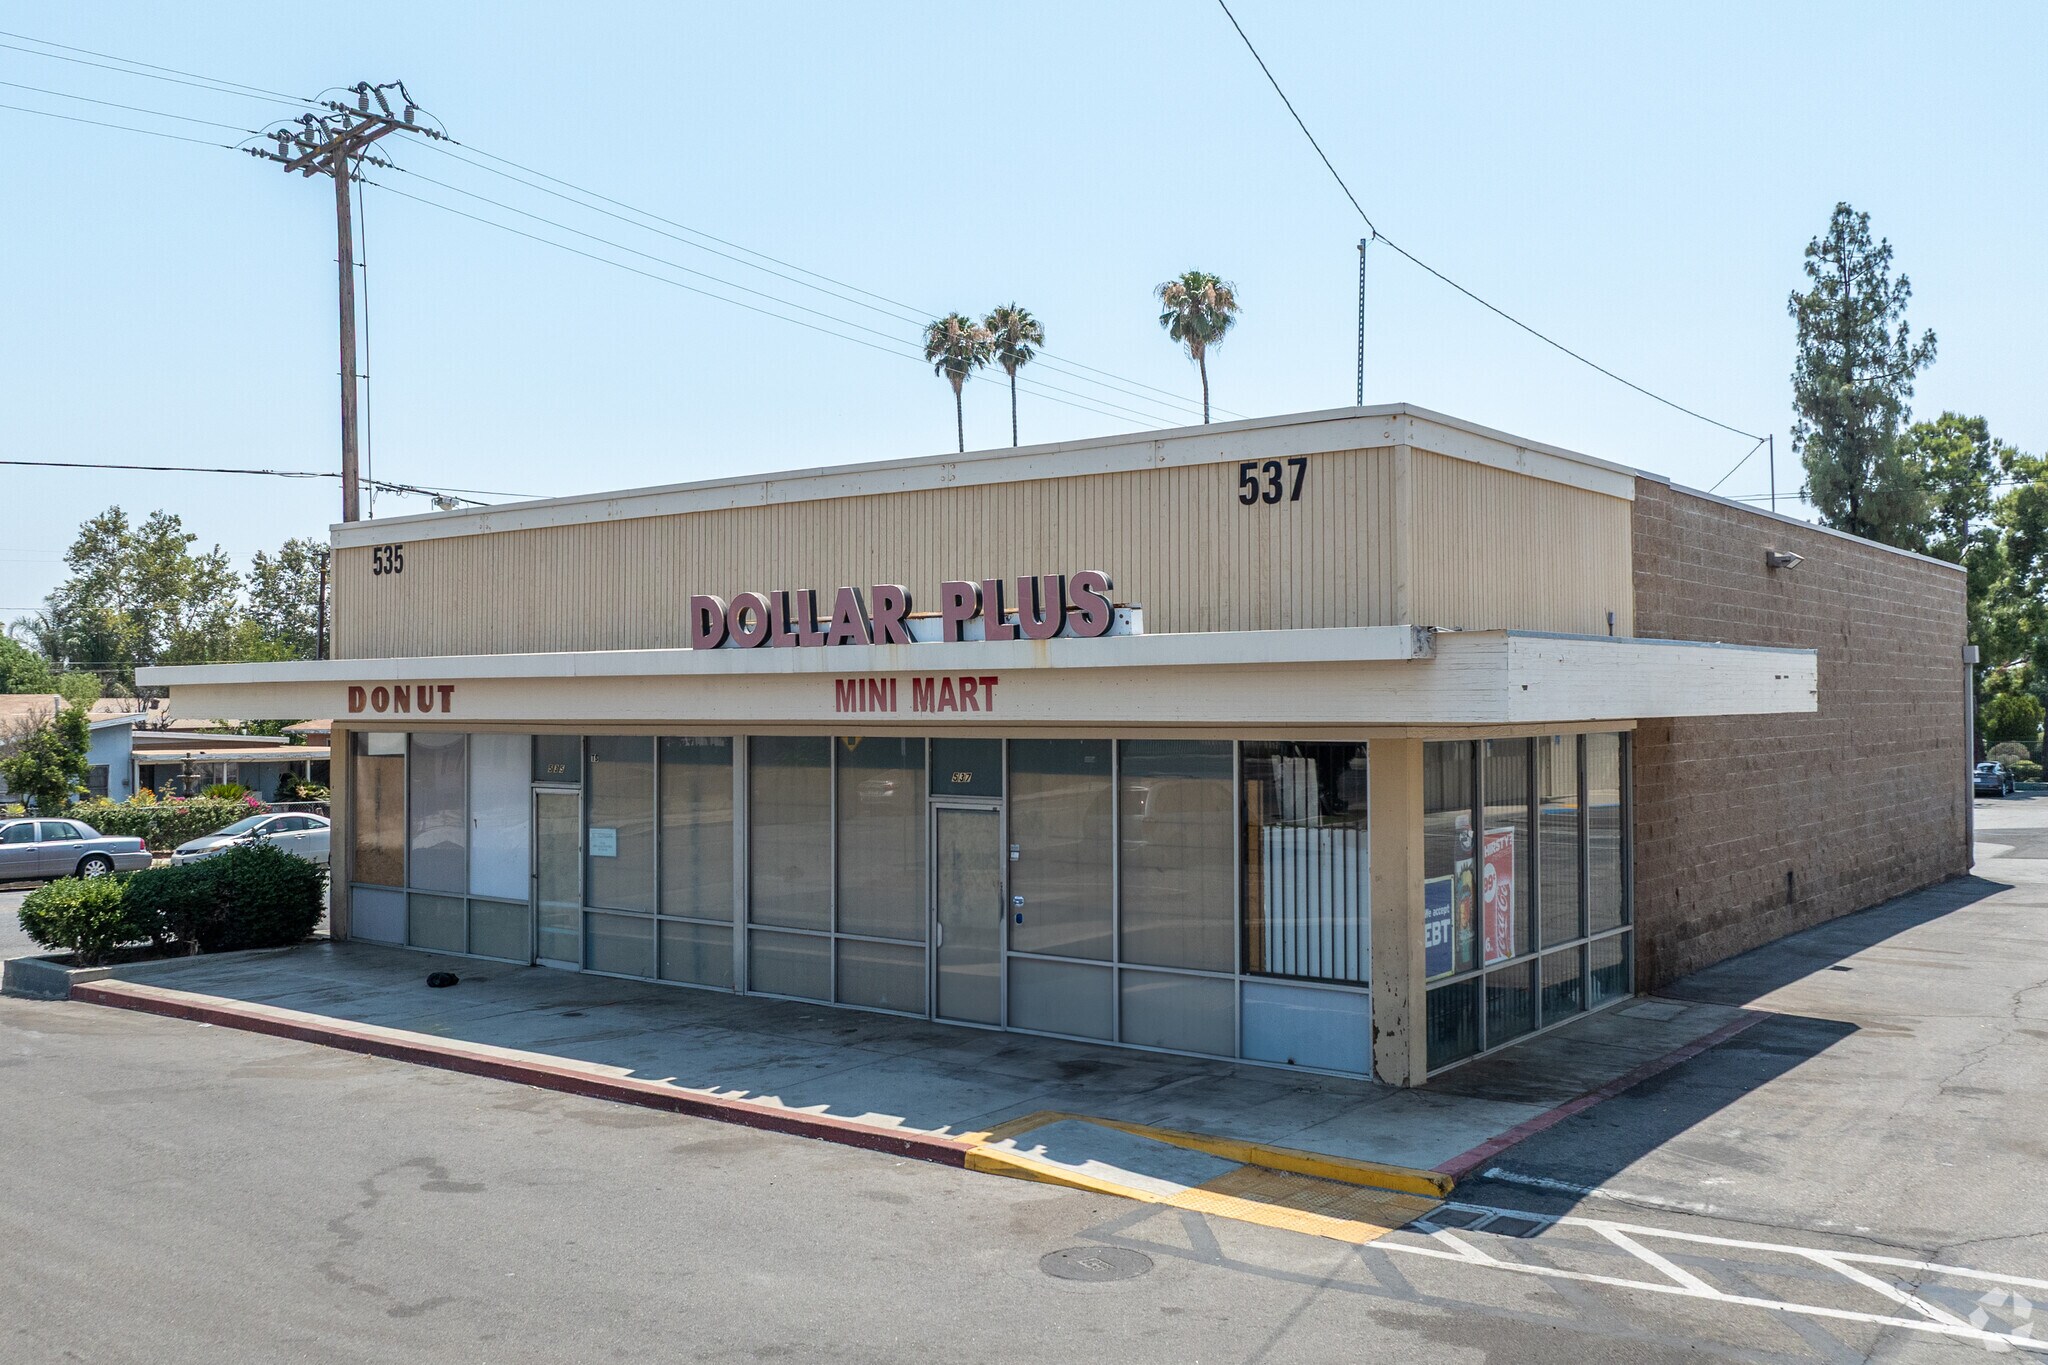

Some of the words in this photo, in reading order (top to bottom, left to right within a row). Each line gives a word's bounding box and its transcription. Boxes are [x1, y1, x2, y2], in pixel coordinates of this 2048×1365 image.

[1239, 457, 1308, 505] 537
[373, 544, 404, 576] 535
[691, 583, 917, 650] DOLLAR
[941, 569, 1115, 642] PLUS
[348, 684, 455, 713] DONUT
[835, 678, 897, 713] MINI
[912, 676, 999, 713] MART
[548, 764, 565, 773] 535
[952, 772, 972, 782] 537
[1484, 833, 1513, 858] HIRSTY?
[1433, 903, 1450, 917] accept
[1425, 919, 1451, 949] EBT
